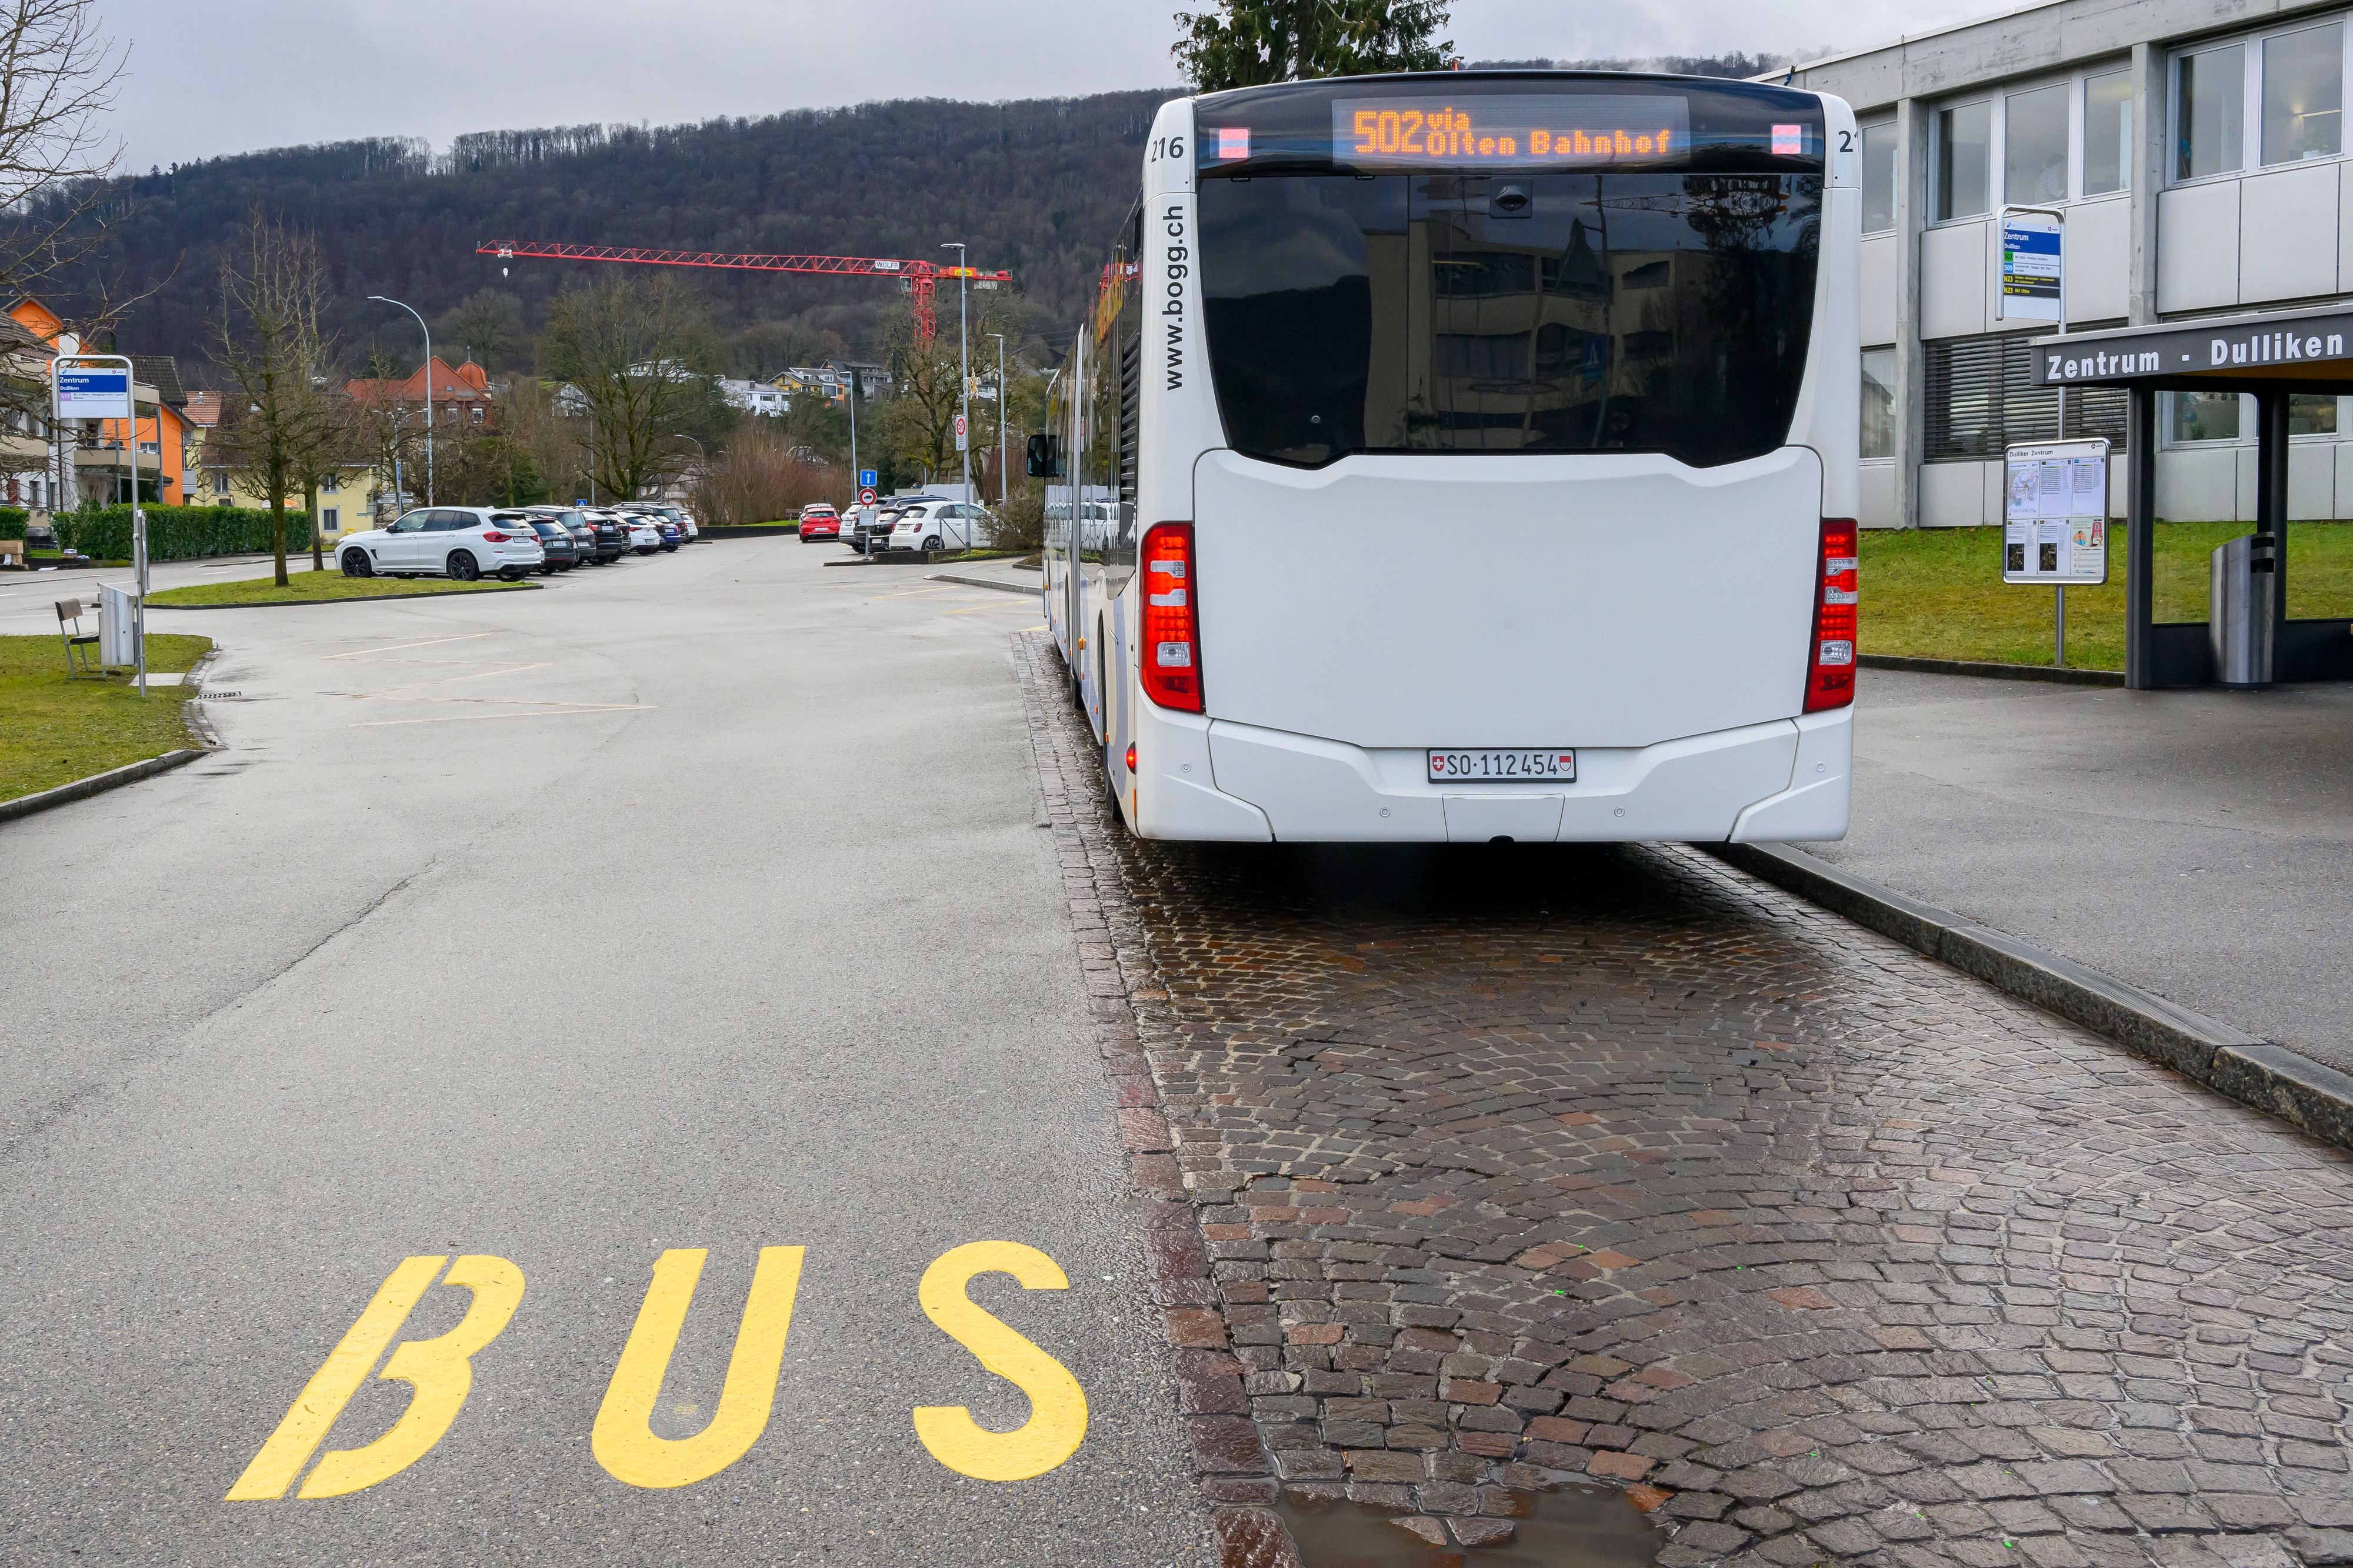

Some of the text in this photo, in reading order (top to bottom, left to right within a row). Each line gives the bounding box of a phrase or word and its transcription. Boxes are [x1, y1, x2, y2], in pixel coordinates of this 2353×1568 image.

[1354, 111, 1424, 153] 502
[1427, 106, 1470, 131] via
[1151, 136, 1184, 163] 216
[1427, 129, 1671, 155] Olten Bahnhof
[1838, 130, 1857, 153] 2
[2004, 232, 2029, 241] Zentrum
[1162, 205, 1188, 391] www.bogg.ch
[2047, 351, 2159, 381] Zentrum
[2211, 332, 2343, 365] Dulliken
[224, 1239, 1089, 1500] BUS
